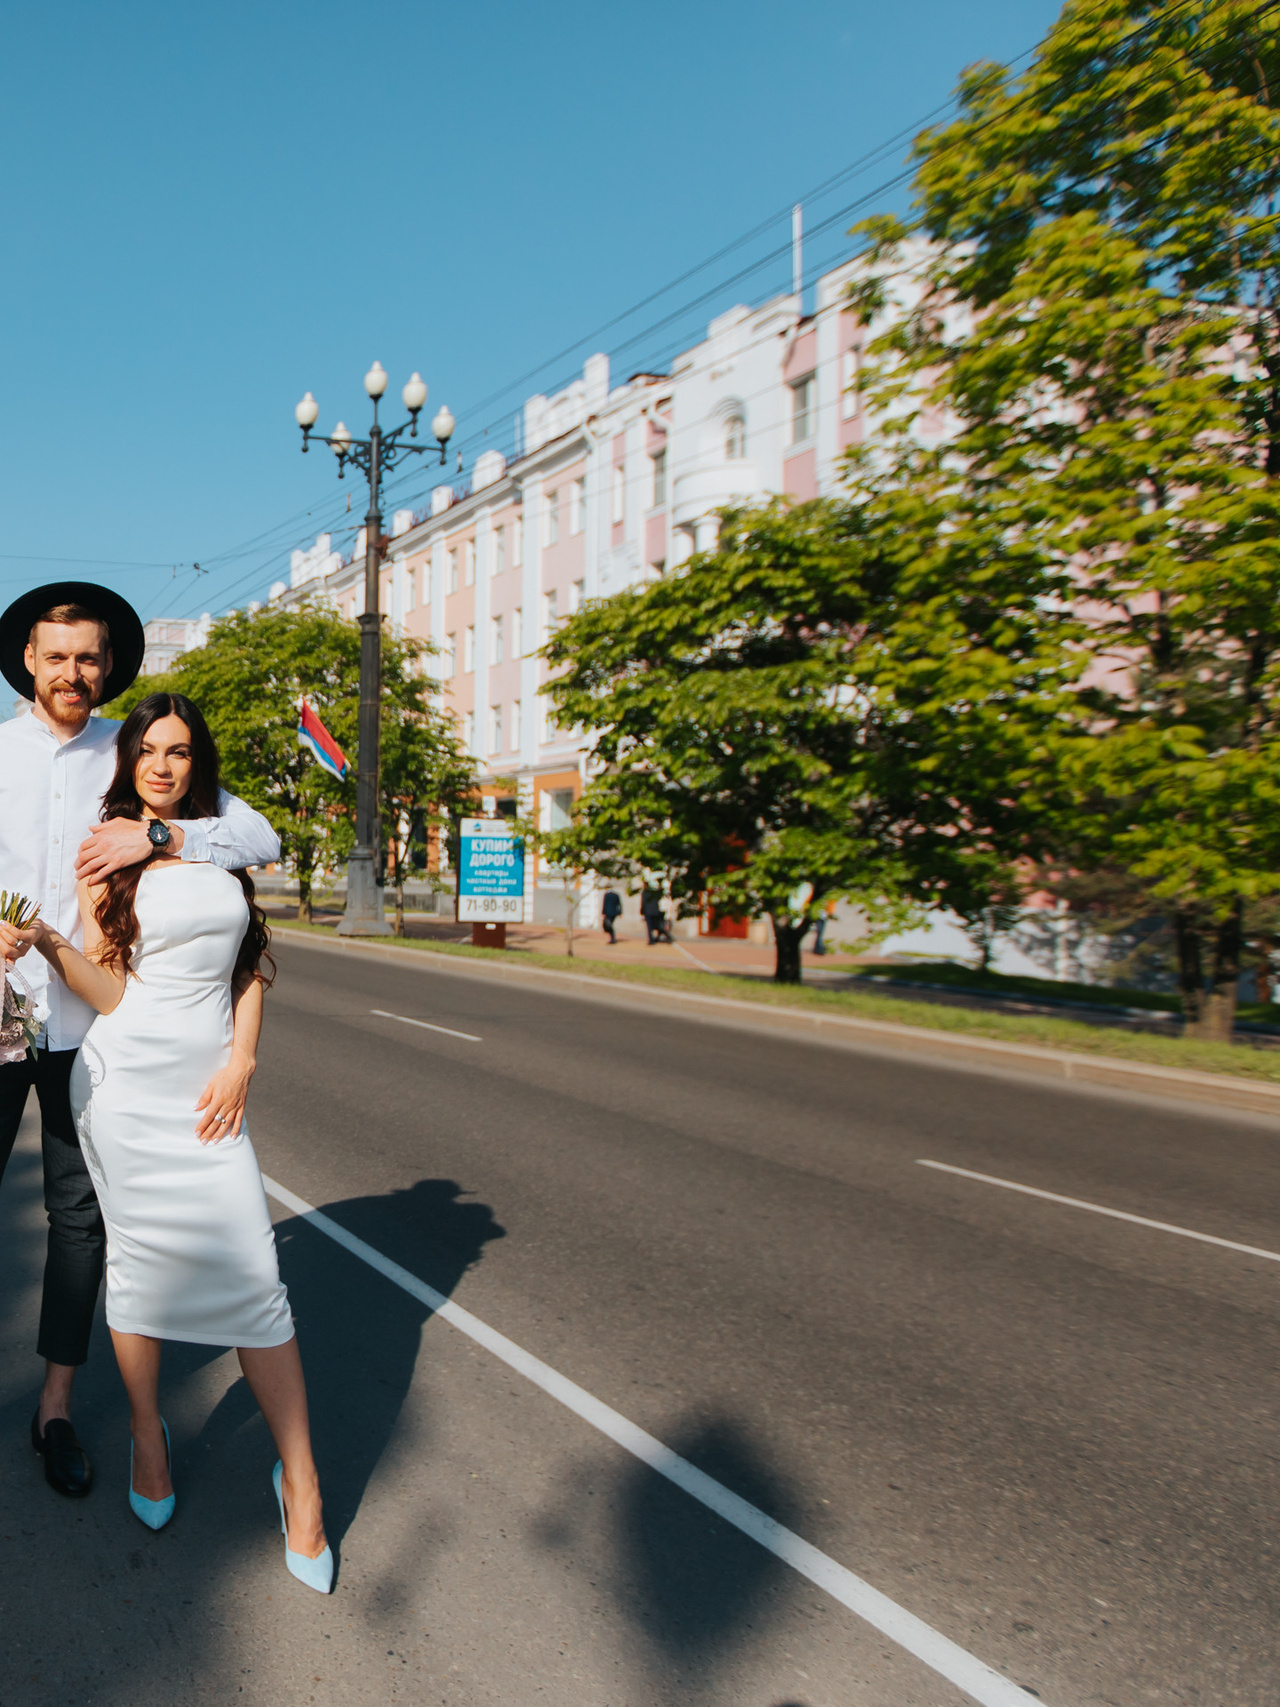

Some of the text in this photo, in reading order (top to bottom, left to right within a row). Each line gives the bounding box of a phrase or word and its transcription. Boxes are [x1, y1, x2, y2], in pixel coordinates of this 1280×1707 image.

[471, 839, 514, 852] КУПИМ
[469, 854, 515, 867] ДОРОГО
[467, 899, 517, 912] 71-90-90
